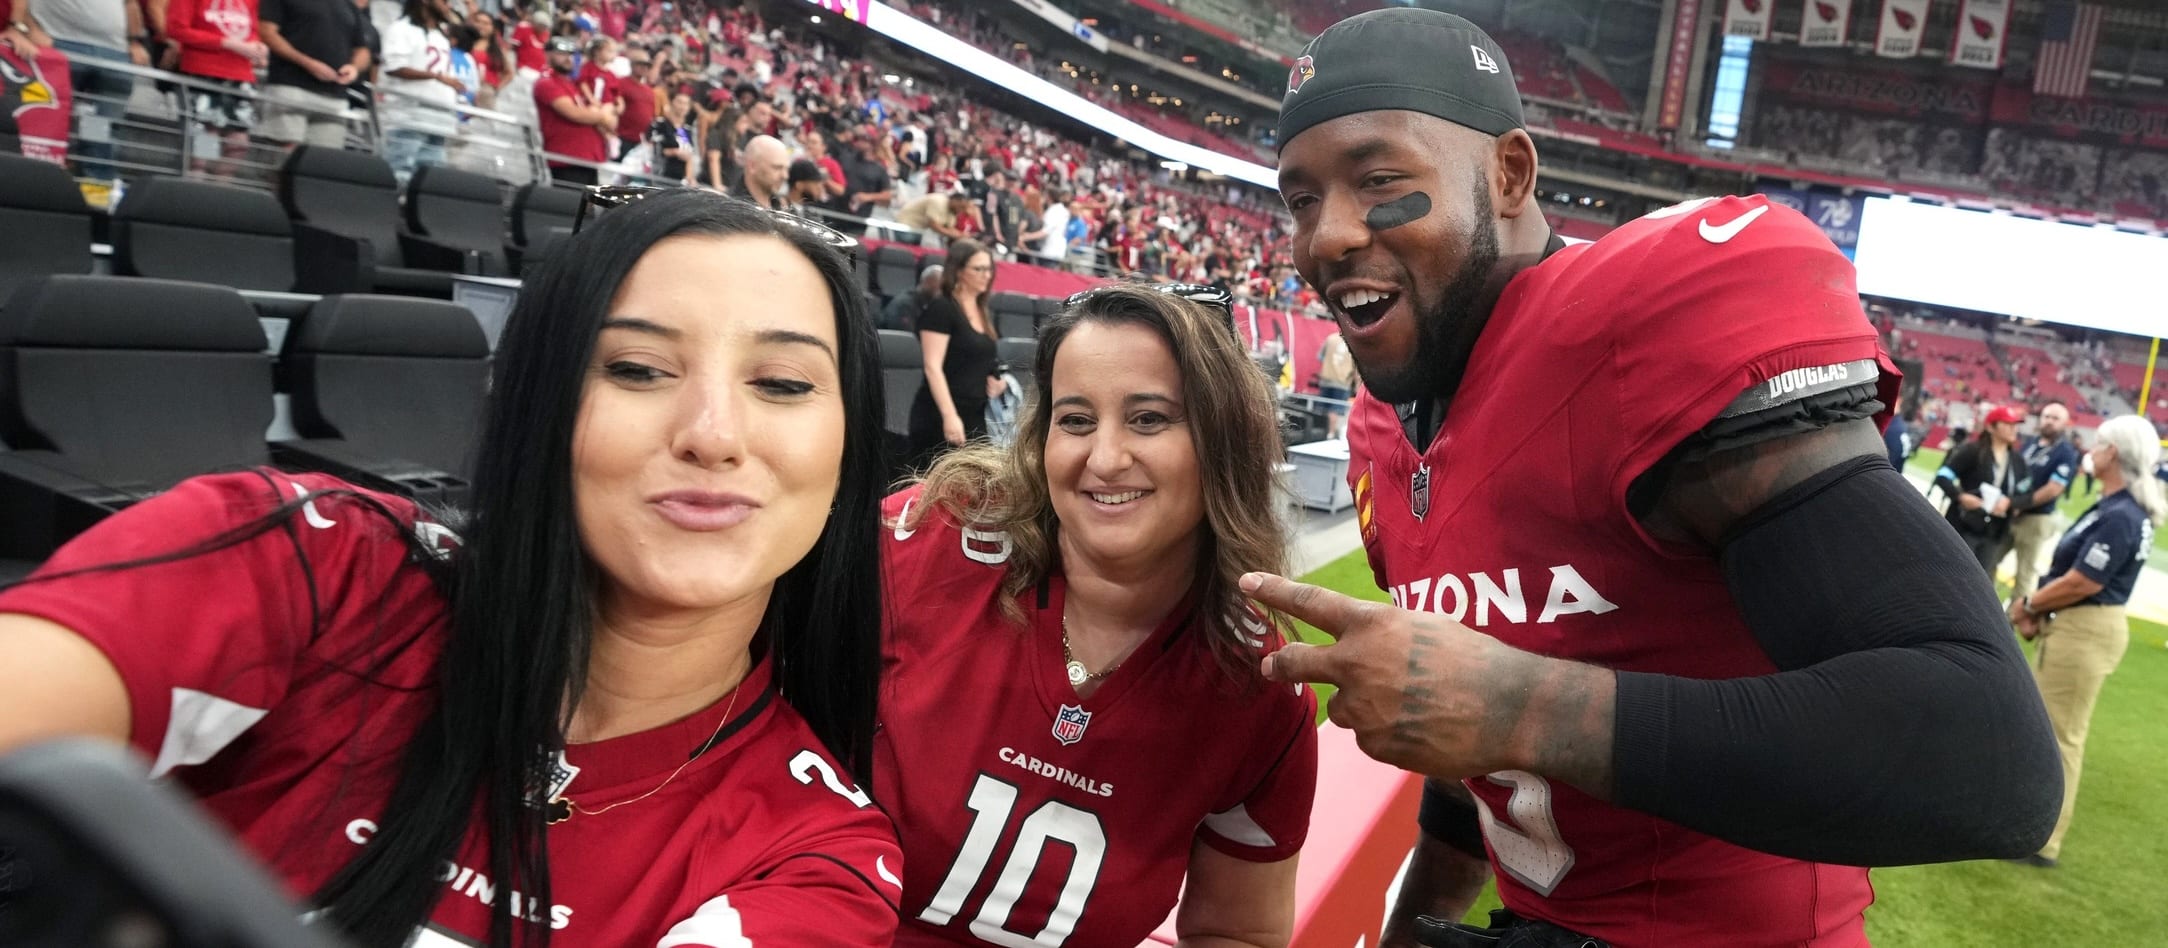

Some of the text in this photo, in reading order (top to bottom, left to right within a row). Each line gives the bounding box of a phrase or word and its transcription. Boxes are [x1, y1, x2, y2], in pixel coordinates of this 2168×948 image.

[1767, 363, 1848, 399] DOUGLAS
[999, 746, 1113, 797] CARDINALS
[915, 771, 1108, 948] 10
